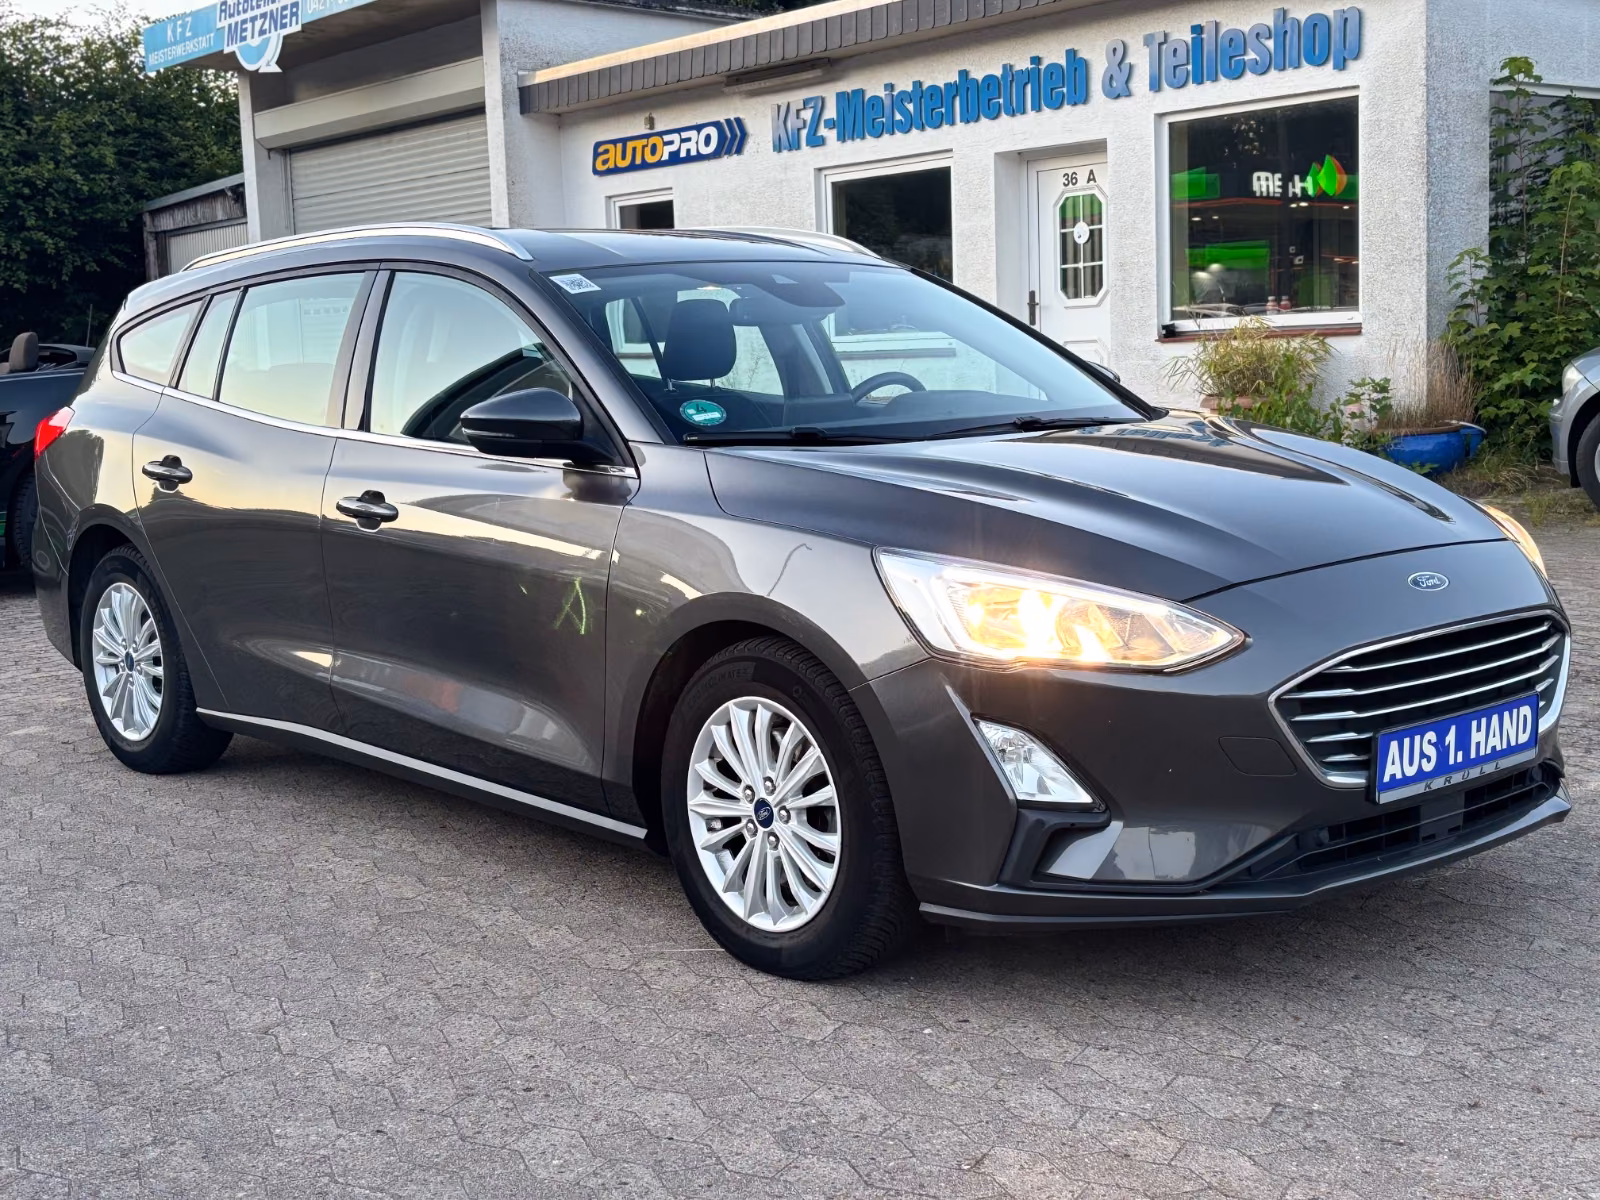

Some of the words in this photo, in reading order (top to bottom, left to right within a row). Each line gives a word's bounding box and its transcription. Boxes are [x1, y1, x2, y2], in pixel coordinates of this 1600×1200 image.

[226, 2, 300, 47] METZNER
[148, 32, 215, 66] MEISTERWERKSTATT
[771, 48, 1089, 152] KFZ-Meisterbetrieb
[1102, 39, 1132, 99] &
[1143, 7, 1361, 92] Teileshop
[1062, 172, 1079, 187] 36
[1086, 169, 1097, 184] A
[695, 403, 708, 413] 4
[1416, 575, 1441, 588] Ford
[1383, 731, 1437, 783] AUS
[1445, 725, 1463, 765] 1.
[1470, 705, 1533, 759] HAND
